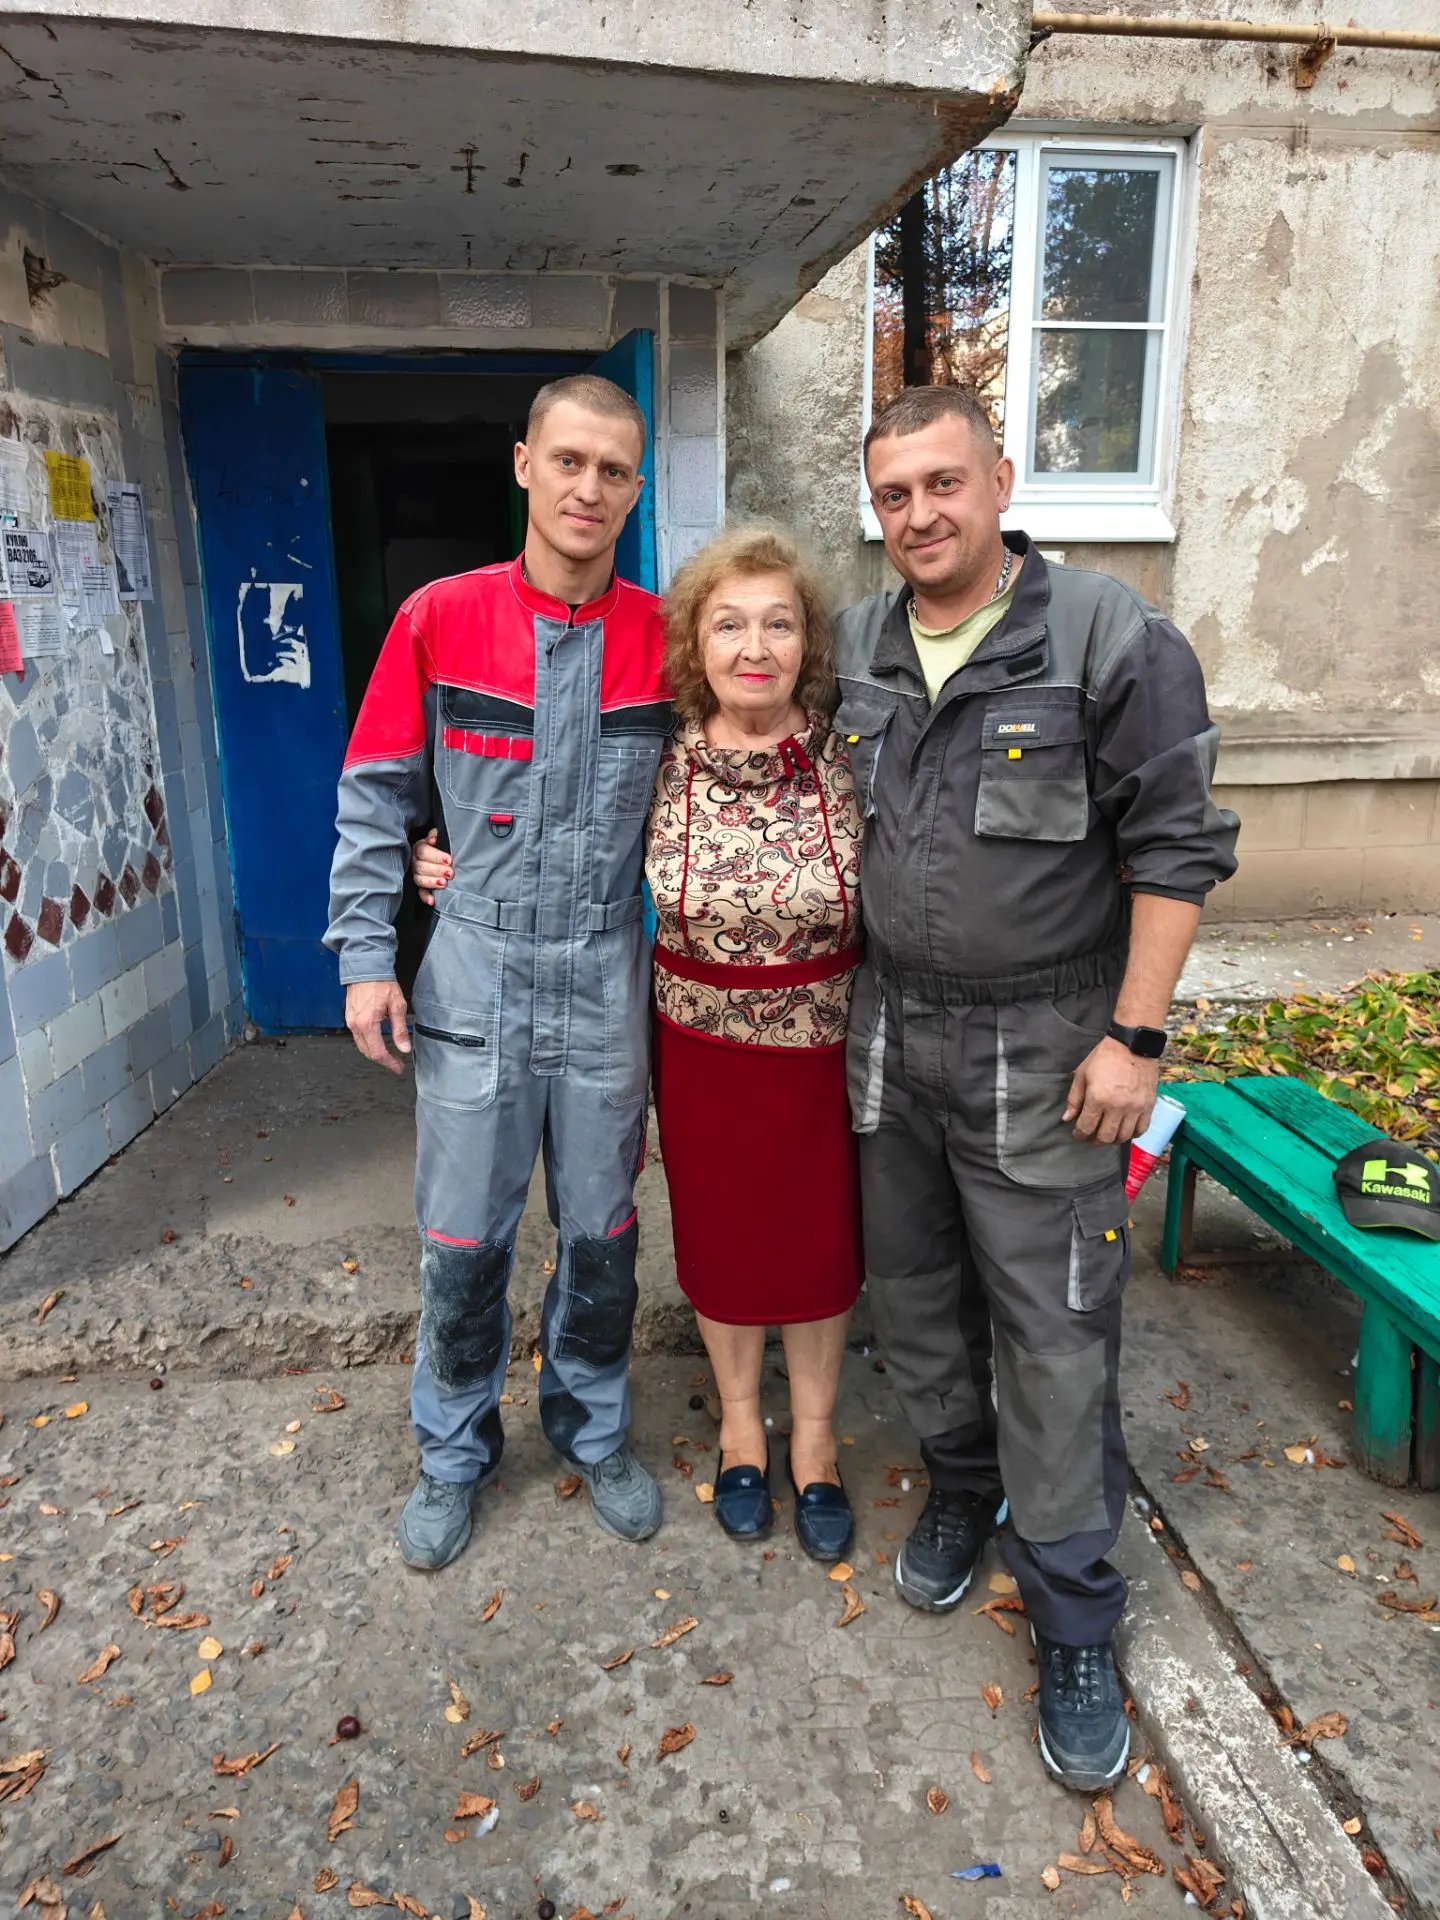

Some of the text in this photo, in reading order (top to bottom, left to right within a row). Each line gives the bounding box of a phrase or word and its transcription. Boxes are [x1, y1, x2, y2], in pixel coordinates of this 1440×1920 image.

[7, 548, 37, 563] ВАЗ 2106
[997, 723, 1036, 733] DOWELL
[1361, 1181, 1431, 1204] Kawasaki
